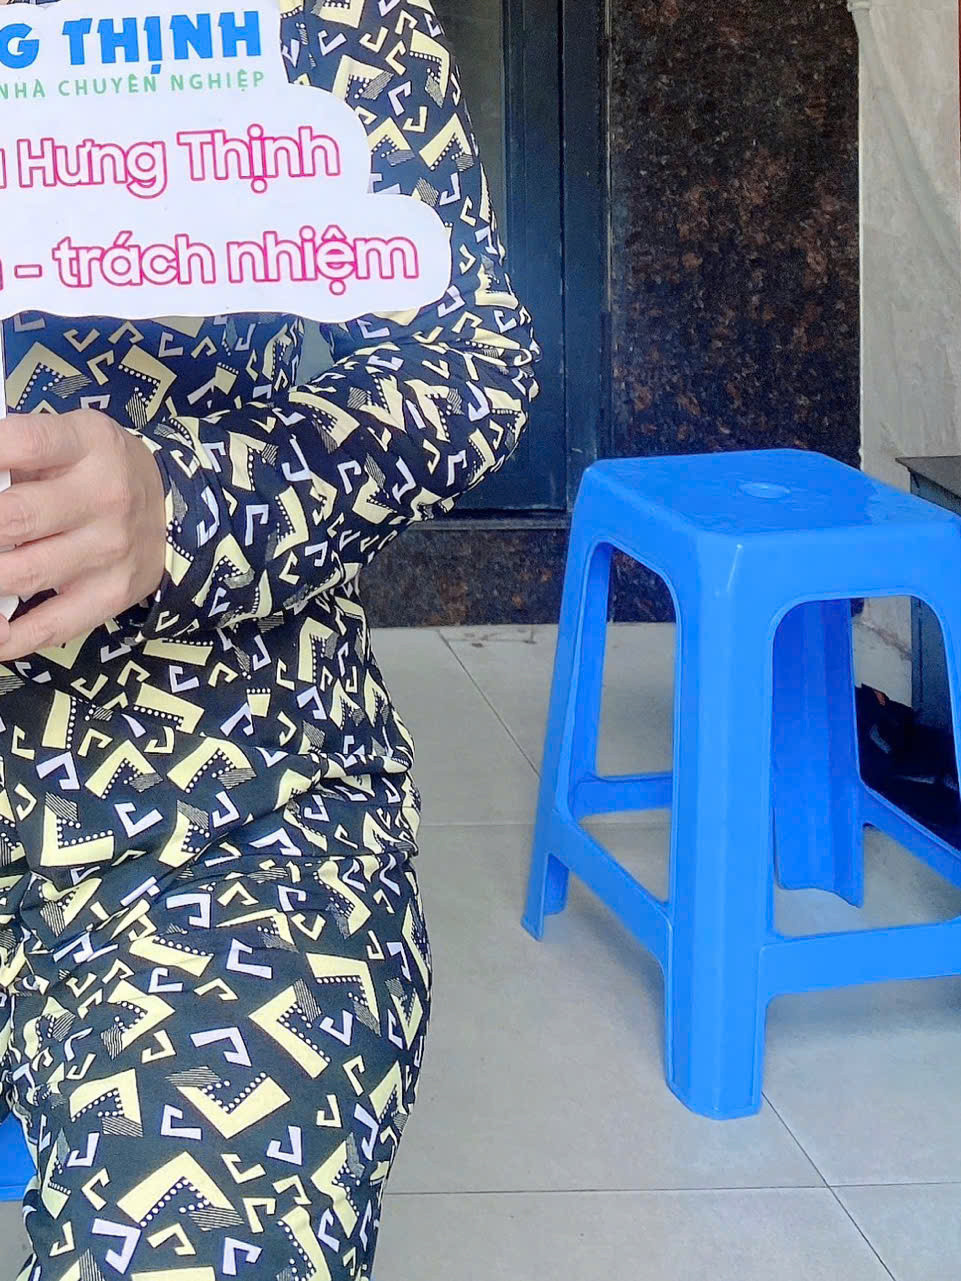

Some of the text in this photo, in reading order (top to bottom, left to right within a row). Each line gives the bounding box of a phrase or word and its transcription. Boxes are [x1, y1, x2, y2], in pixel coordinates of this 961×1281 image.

[62, 10, 262, 75] THỊNH
[57, 72, 158, 98] CHUYÊN
[170, 68, 266, 94] NGHIỆP
[16, 136, 168, 200] Hưng
[175, 123, 342, 195] Thịnh
[51, 230, 217, 289] trách
[225, 224, 420, 295] nhiệm
